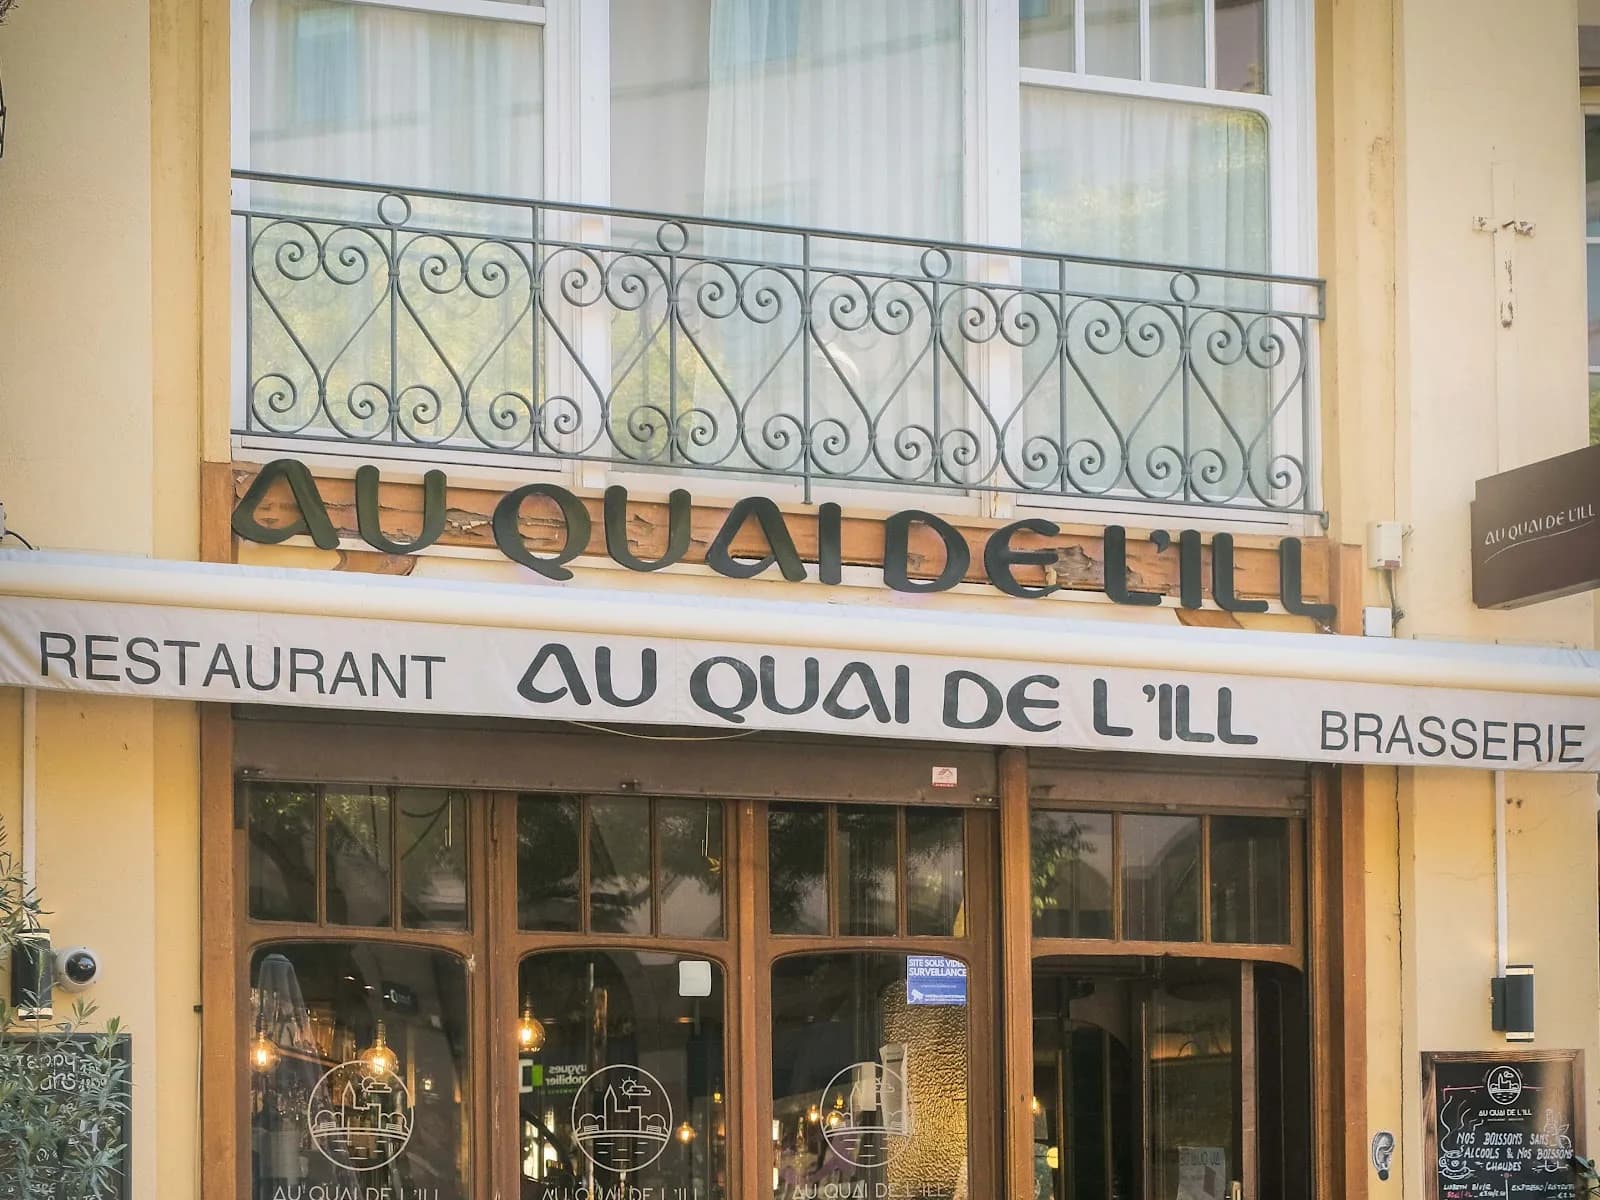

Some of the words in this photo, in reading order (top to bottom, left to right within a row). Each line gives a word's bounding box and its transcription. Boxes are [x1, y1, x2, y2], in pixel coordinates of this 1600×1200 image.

[1484, 528, 1505, 546] AU
[1508, 517, 1543, 541] QUAI
[1546, 511, 1565, 529] DE
[1568, 504, 1596, 522] L'ILL
[231, 458, 447, 555] AU
[492, 482, 842, 587] QUAI
[884, 509, 1061, 599] DE
[1104, 525, 1337, 620] L'ILL
[40, 631, 446, 700] RESTAURANT
[517, 643, 657, 708] AU
[690, 655, 910, 725] QUAI
[943, 670, 1061, 733] DE
[1093, 679, 1258, 745] L'ILL
[1321, 711, 1585, 763] BRASSERIE
[909, 959, 924, 967] SITE
[909, 968, 967, 976] SURVEILLANCE
[1478, 1109, 1488, 1117] AU
[1506, 1108, 1517, 1116] DE
[1457, 1133, 1475, 1144] NOS
[1483, 1132, 1523, 1145] BOISSONS
[1530, 1133, 1549, 1145] SANS
[1464, 1147, 1500, 1159] ALCOOLS
[1516, 1147, 1532, 1160] NOS
[1536, 1147, 1574, 1160] BOISSONS
[1485, 1161, 1522, 1172] CHAUDES
[792, 1183, 817, 1199] AU
[824, 1183, 868, 1199] QUAI
[876, 1183, 899, 1198] DE
